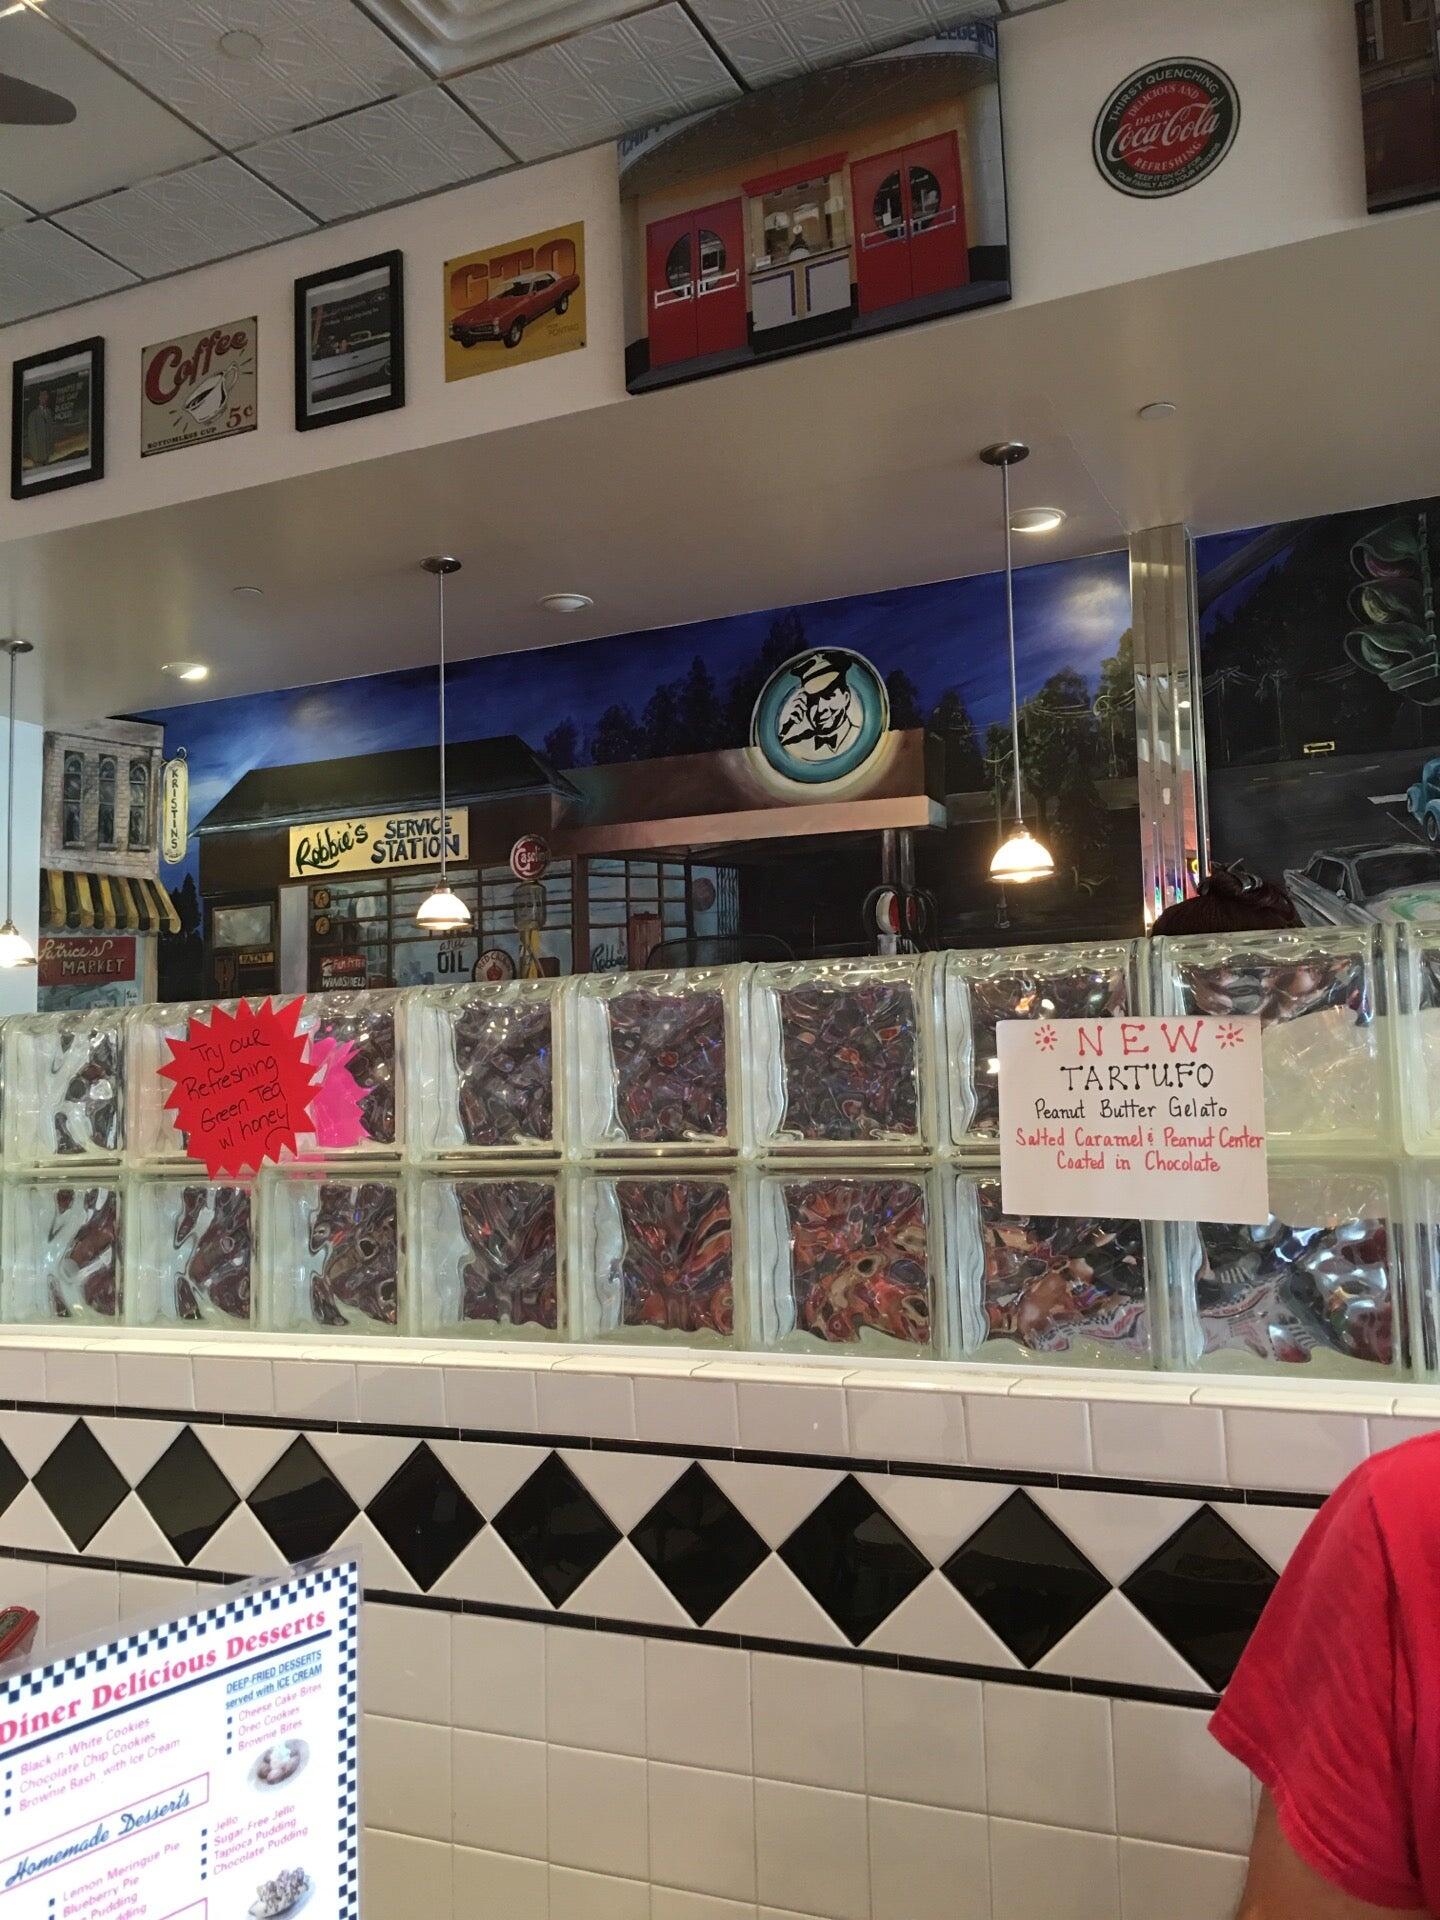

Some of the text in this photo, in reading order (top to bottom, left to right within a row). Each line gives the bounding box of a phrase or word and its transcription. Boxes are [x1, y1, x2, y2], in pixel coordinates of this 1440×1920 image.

[1108, 68, 1220, 122] THIRST QUENCHING
[1128, 84, 1200, 117] DELICIOUS AND
[1106, 95, 1226, 161] Coca-Cola
[1135, 109, 1172, 126] DRINK
[1134, 142, 1202, 171] REFRESHING
[451, 238, 576, 310] GTO
[145, 330, 249, 405] Coffee
[200, 427, 217, 437] CUP
[296, 815, 453, 874] Robbie's SERVICE
[371, 834, 460, 864] STATION
[39, 939, 114, 960] Patrice's
[62, 959, 125, 976] MARKET
[437, 951, 469, 974] OIL
[1077, 1020, 1203, 1056] NEW
[182, 1055, 279, 1100] Refreshing
[191, 1043, 225, 1079] Try
[1060, 1061, 1214, 1090] TARTUFO
[201, 1082, 287, 1132] Green Tea
[1035, 1096, 1228, 1119] Peanut Butter Gelato
[240, 1103, 291, 1150] honey
[1016, 1127, 1065, 1147] Salted
[1075, 1125, 1143, 1147] Caramel
[1164, 1126, 1214, 1148] Peanut
[1219, 1125, 1265, 1149] Center
[1057, 1150, 1221, 1173] Coated in Chocolate
[0, 1611, 325, 1746] Diner Delicious Desserts
[279, 1650, 322, 1674] DESSERTS
[226, 1663, 322, 1710] served with ICE CREAM
[239, 1683, 322, 1721] Cheese Cake Bites
[106, 1718, 151, 1741] Cookies
[264, 1706, 300, 1726] Cookies
[238, 1719, 303, 1751] Brownie Bites
[19, 1739, 181, 1811] Brownie Bash with Ice Cream
[20, 1733, 156, 1793] Chocolate Chip Cookies
[5, 1789, 190, 1887] Homemade Desserts
[214, 1816, 239, 1833] Jello
[214, 1805, 295, 1847] Sugar Free Jello
[214, 1818, 297, 1860] Tapioca Pudding
[213, 1827, 308, 1875] Chocolate Pudding
[63, 1842, 180, 1902] Lemon Meringue Pie
[63, 1876, 140, 1918] Blueberry Pie
[90, 1893, 138, 1919] Pudding
